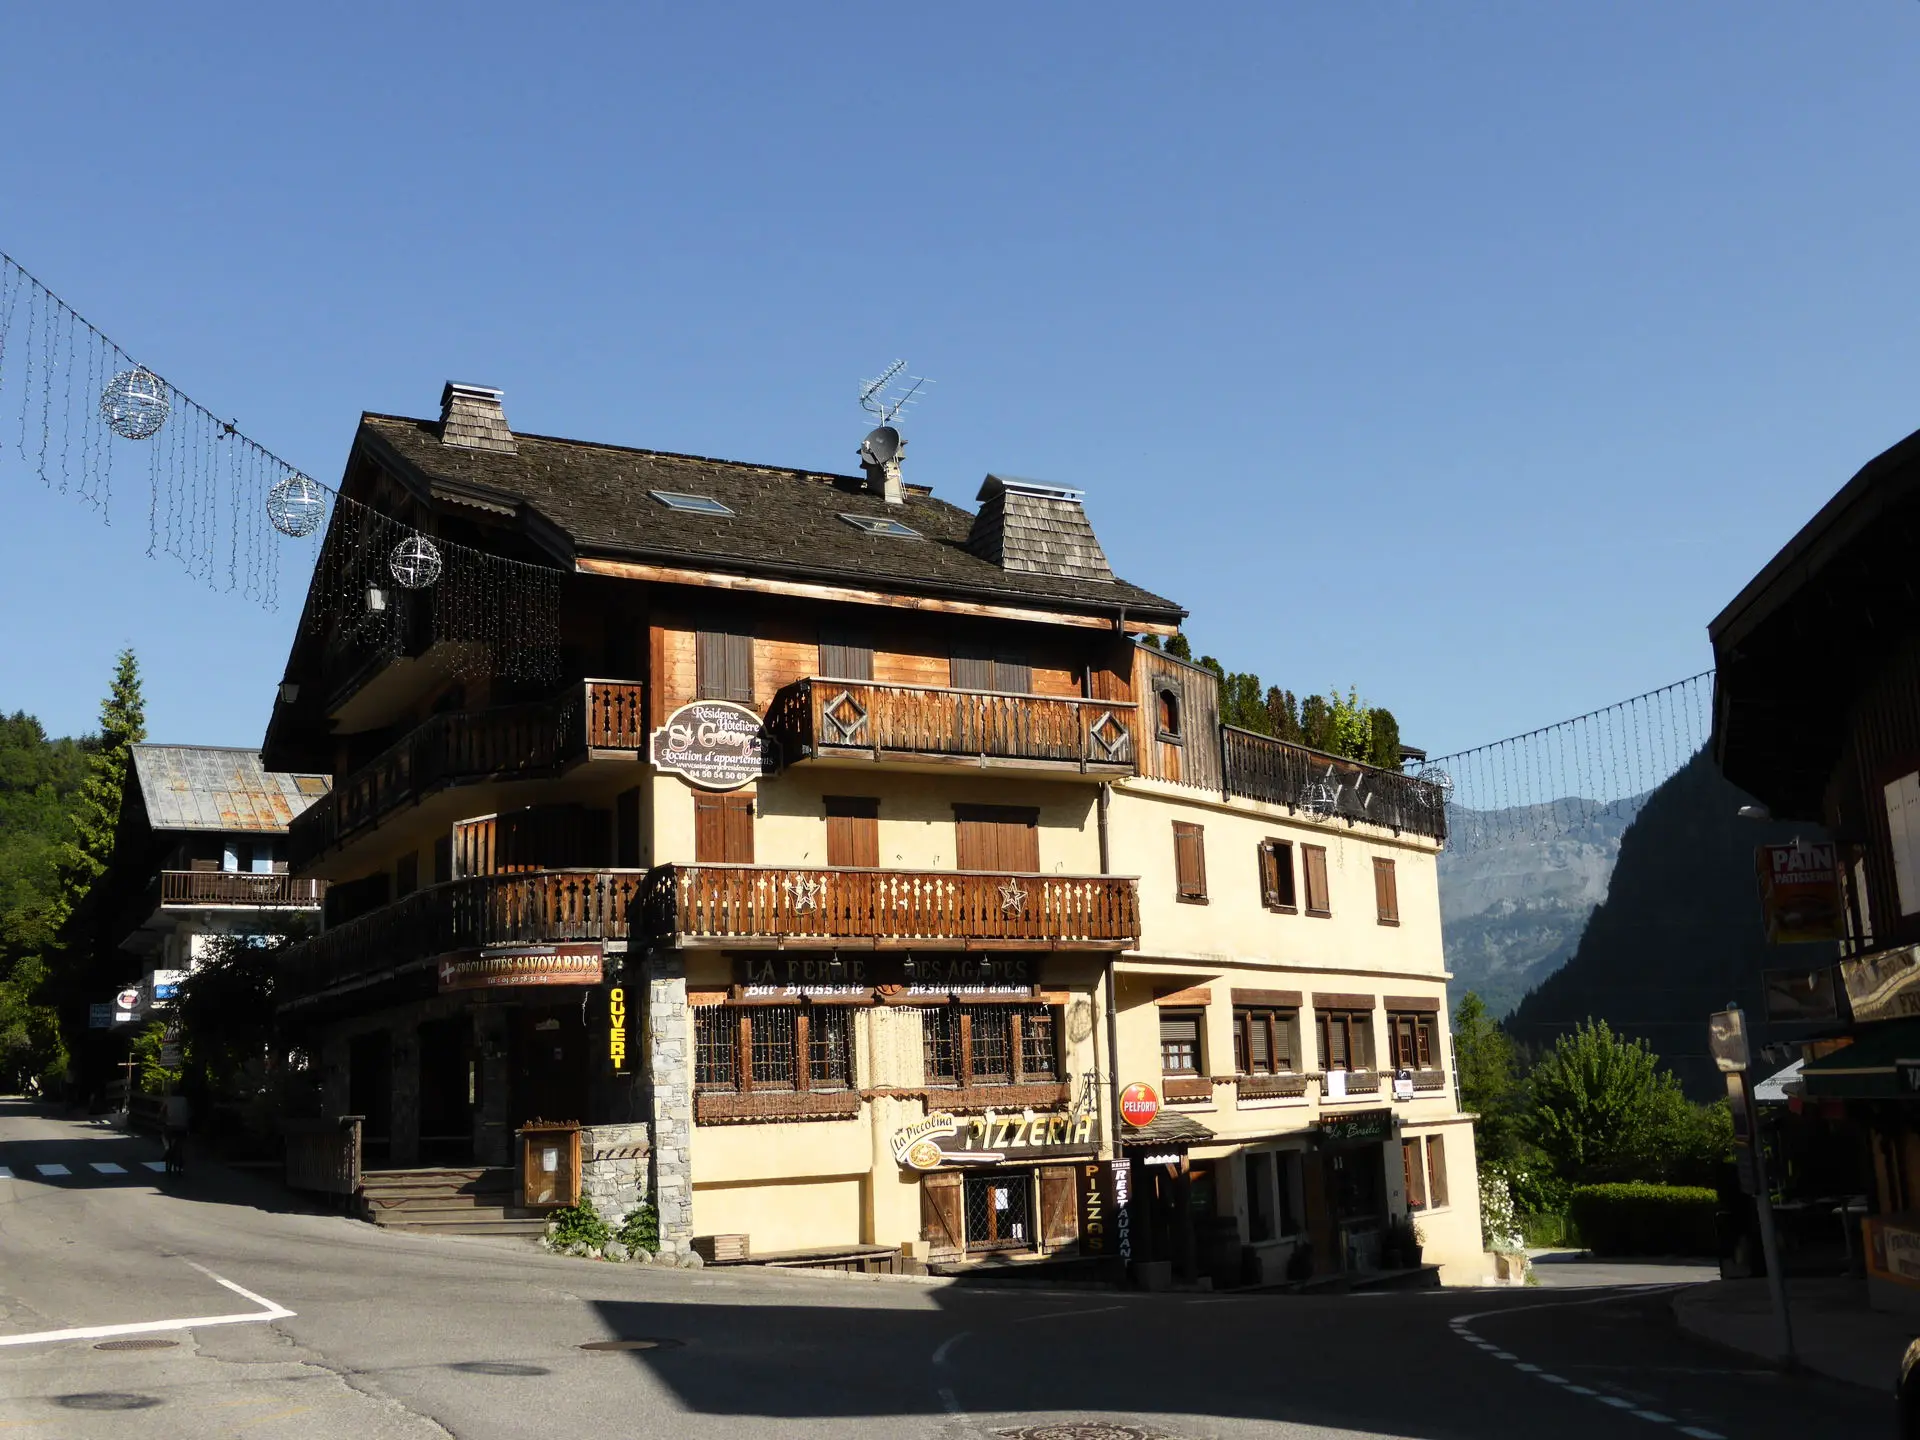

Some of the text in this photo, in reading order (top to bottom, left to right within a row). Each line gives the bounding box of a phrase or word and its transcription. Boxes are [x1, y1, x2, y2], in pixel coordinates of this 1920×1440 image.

[692, 706, 739, 722] Résidence
[716, 718, 760, 733] Hôtelière
[668, 721, 770, 756] St Georges
[661, 748, 702, 763] Location
[1772, 847, 1833, 872] PAIN
[455, 954, 599, 974] SPÉCIALITÉS SAVOYARDES
[744, 960, 777, 983] LA
[744, 982, 778, 997] Bar
[783, 982, 865, 997] Brasserie
[906, 981, 986, 996] Restaurant
[610, 988, 627, 1069] OUVERT
[894, 1114, 953, 1152] La Piccolina
[965, 1115, 1095, 1151] PIZZERIA
[1085, 1164, 1104, 1251] PIZZAS
[1114, 1169, 1132, 1269] RESTAURANT
